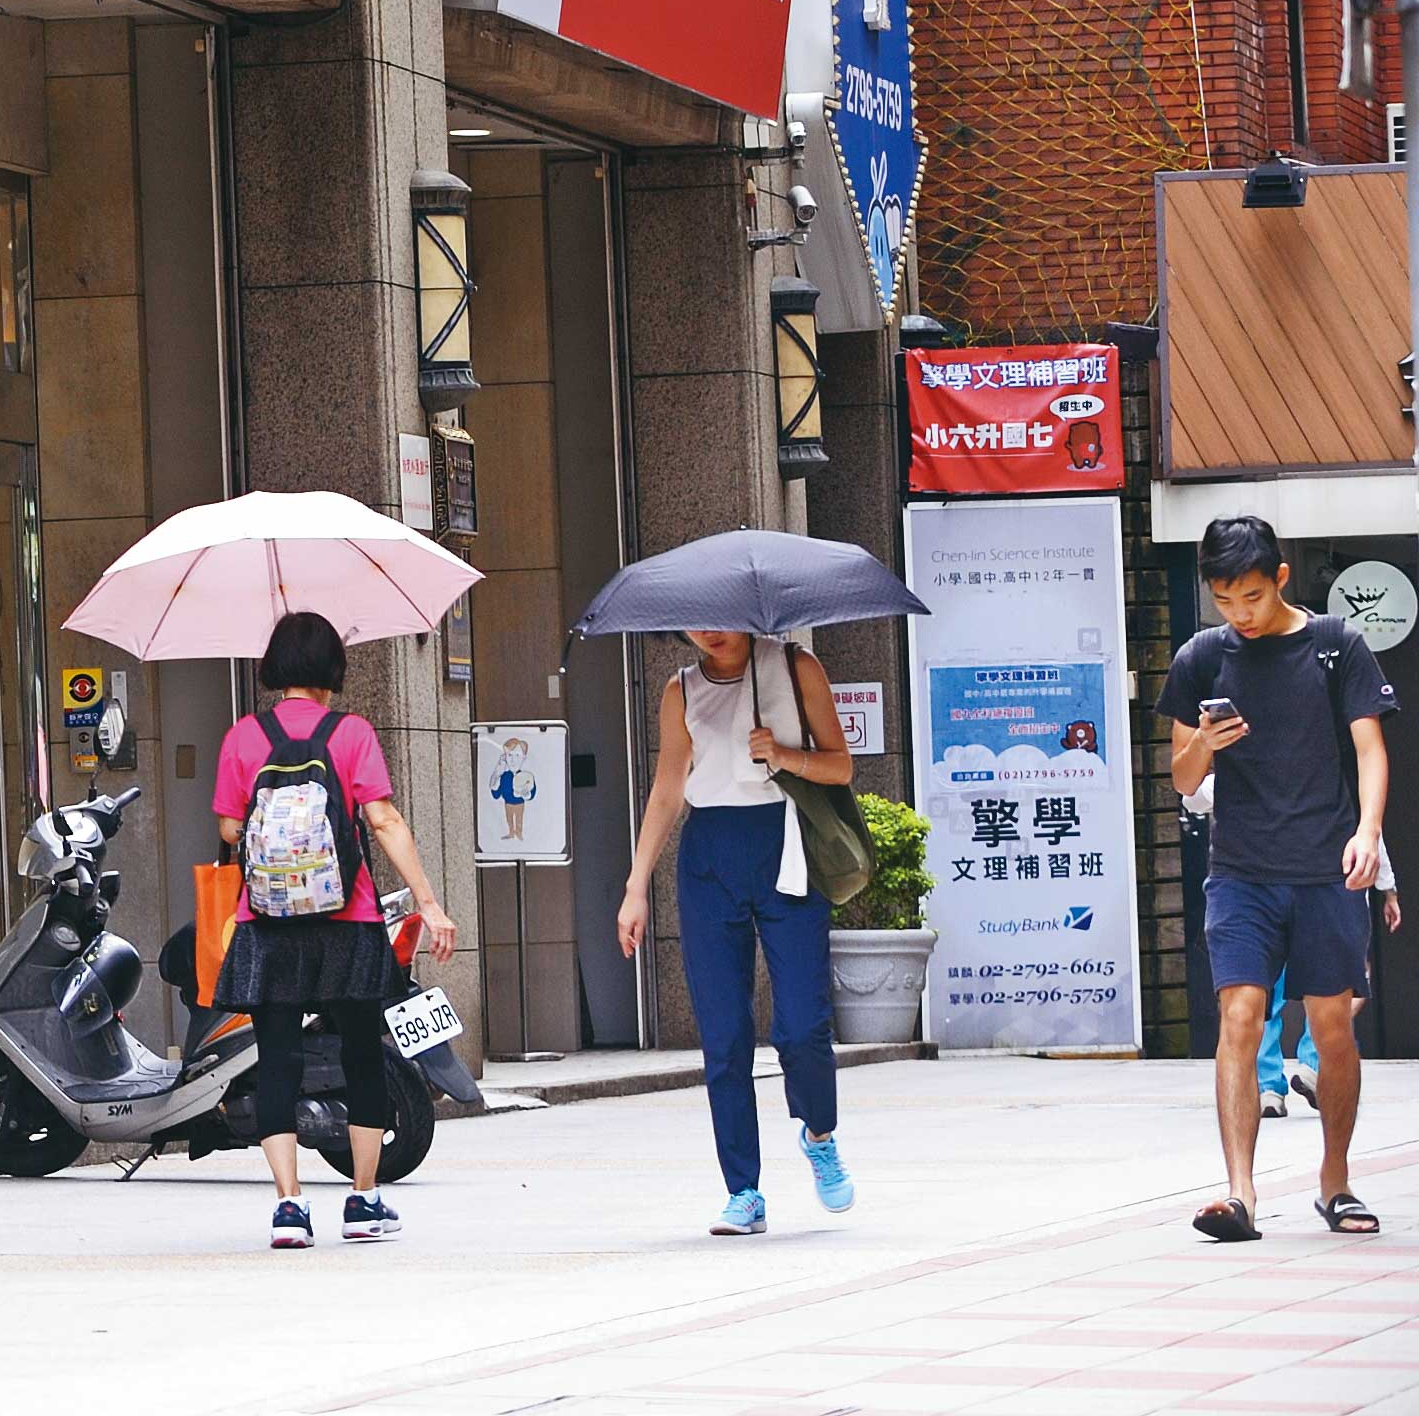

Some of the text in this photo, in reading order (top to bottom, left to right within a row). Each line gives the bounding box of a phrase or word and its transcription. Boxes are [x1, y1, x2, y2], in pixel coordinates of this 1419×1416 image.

[845, 64, 903, 131] 2796-5759
[921, 355, 1107, 390] 擎學文理補習班
[925, 422, 1053, 450] 小六升國七
[990, 547, 1039, 561] Science
[1043, 546, 1095, 560] Institute
[998, 769, 1095, 781] (02)2796-5759
[971, 796, 1081, 848] 擎學
[951, 852, 1104, 883] 文理補習班
[978, 917, 1060, 936] StudyBank
[107, 1103, 133, 1116] SYM
